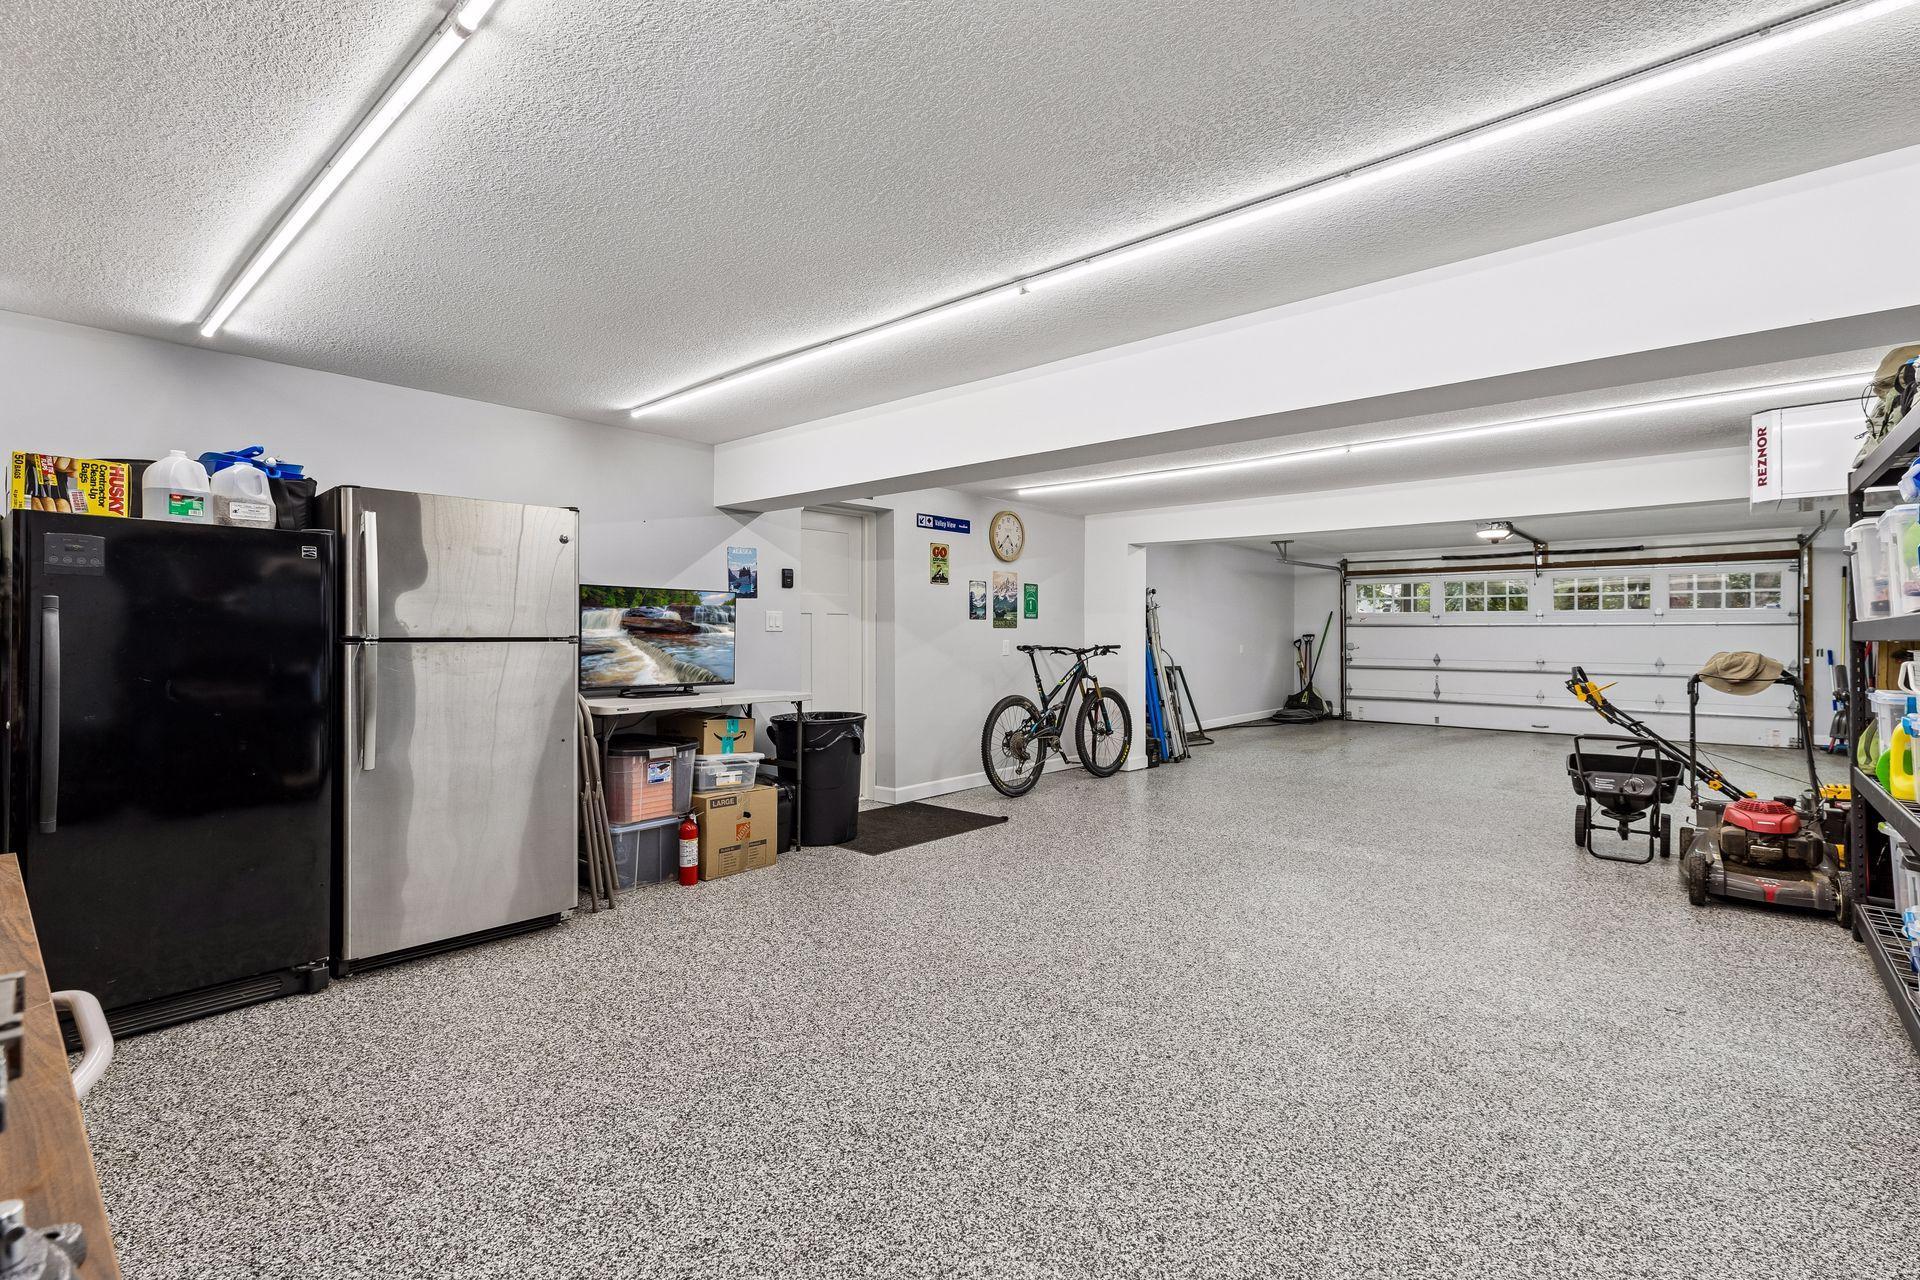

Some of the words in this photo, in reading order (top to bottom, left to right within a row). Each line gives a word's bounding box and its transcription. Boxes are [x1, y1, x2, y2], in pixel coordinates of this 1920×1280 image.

[14, 454, 24, 464] 50
[1756, 426, 1768, 488] REZNOR
[14, 464, 22, 480] BAGS
[78, 462, 90, 484] Bags
[88, 463, 98, 500] Clean-Up
[98, 464, 108, 508] Contractor
[108, 466, 124, 516] HUSKY
[934, 520, 946, 528] Valley
[932, 546, 947, 558] GO
[712, 798, 735, 808] LARGE
